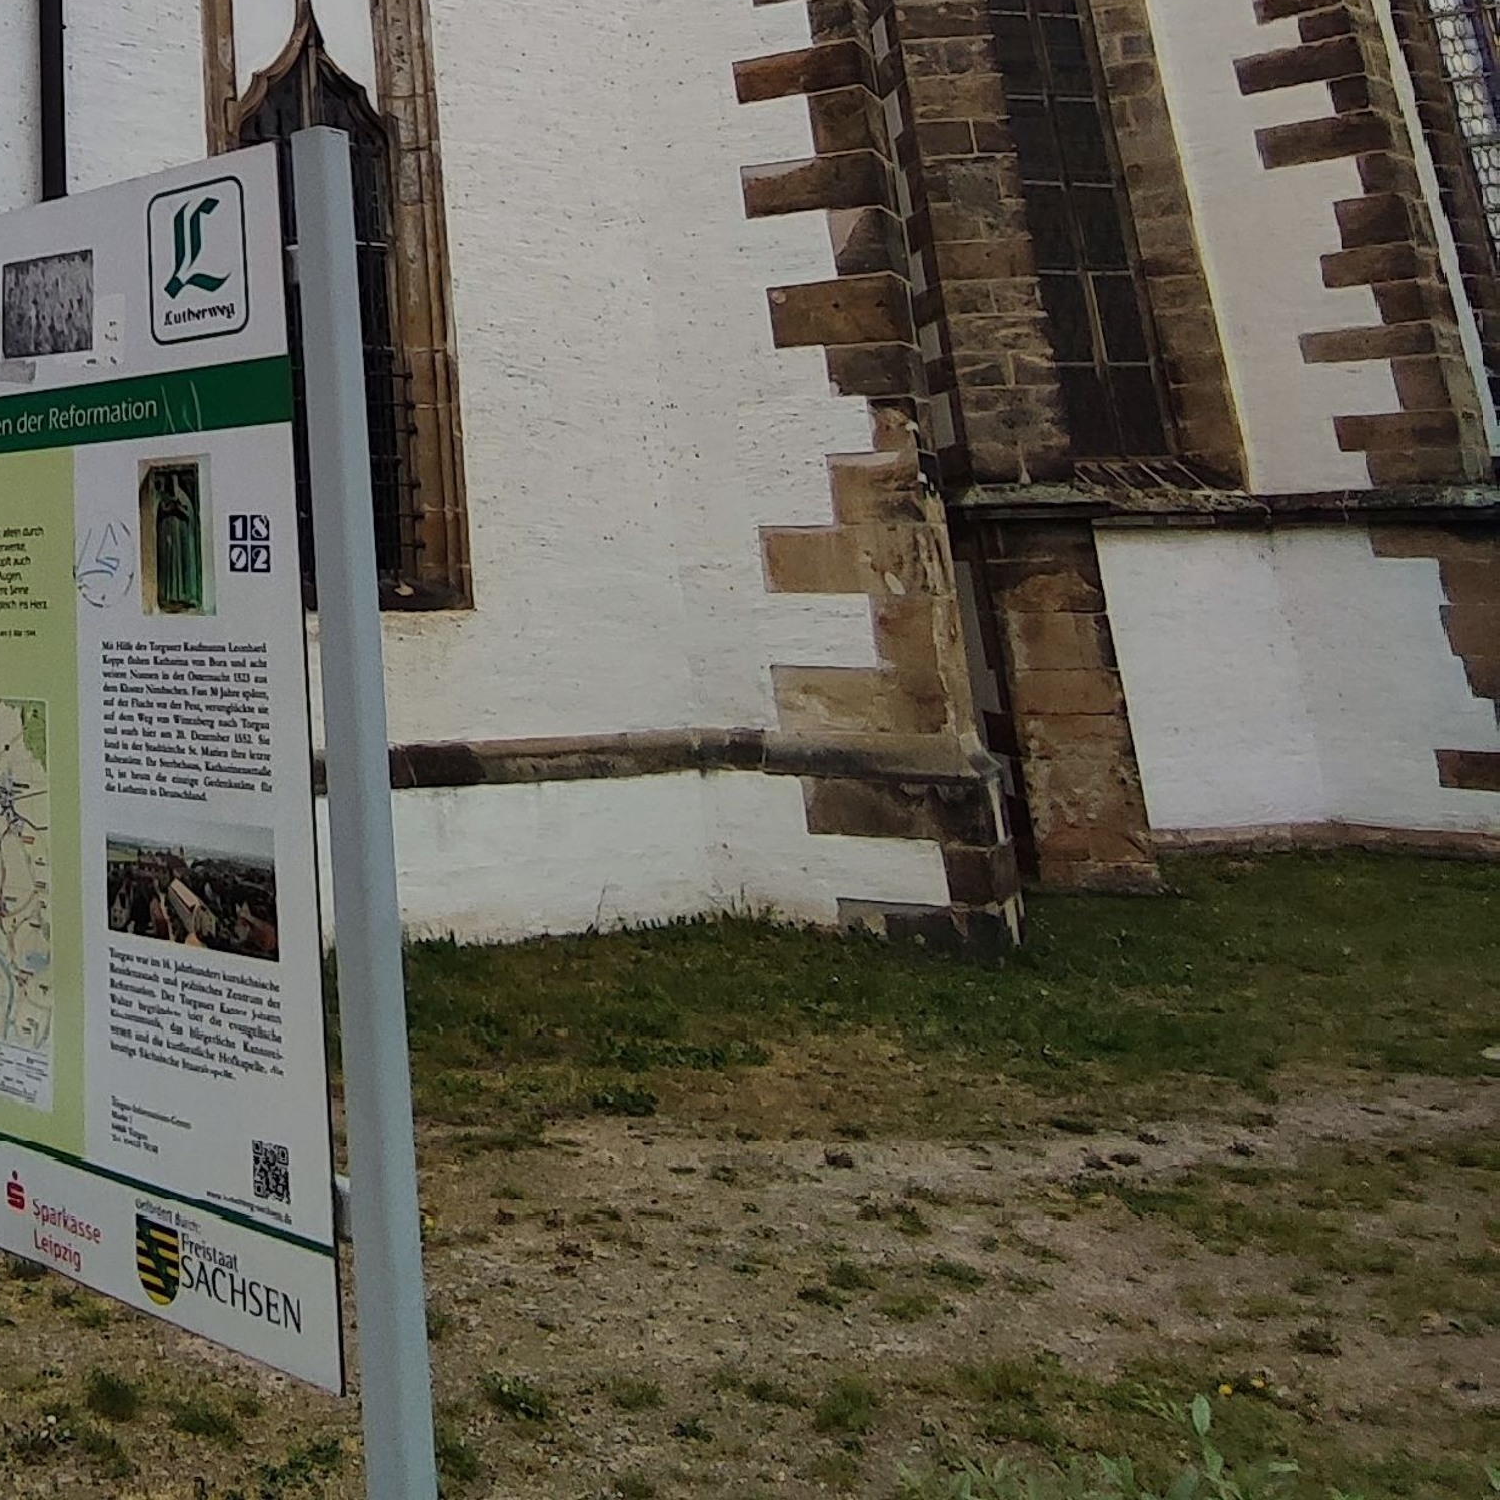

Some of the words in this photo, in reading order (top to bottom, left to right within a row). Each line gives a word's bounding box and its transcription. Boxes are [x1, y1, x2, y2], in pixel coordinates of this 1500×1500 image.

[163, 303, 235, 326] Lutherweg
[16, 412, 44, 435] der
[48, 398, 157, 430] Reformation
[33, 1198, 101, 1244] Sparkasse
[33, 1228, 82, 1272] Leipzig
[181, 1232, 238, 1273] Freistaat
[181, 1255, 302, 1333] SACHSEN
